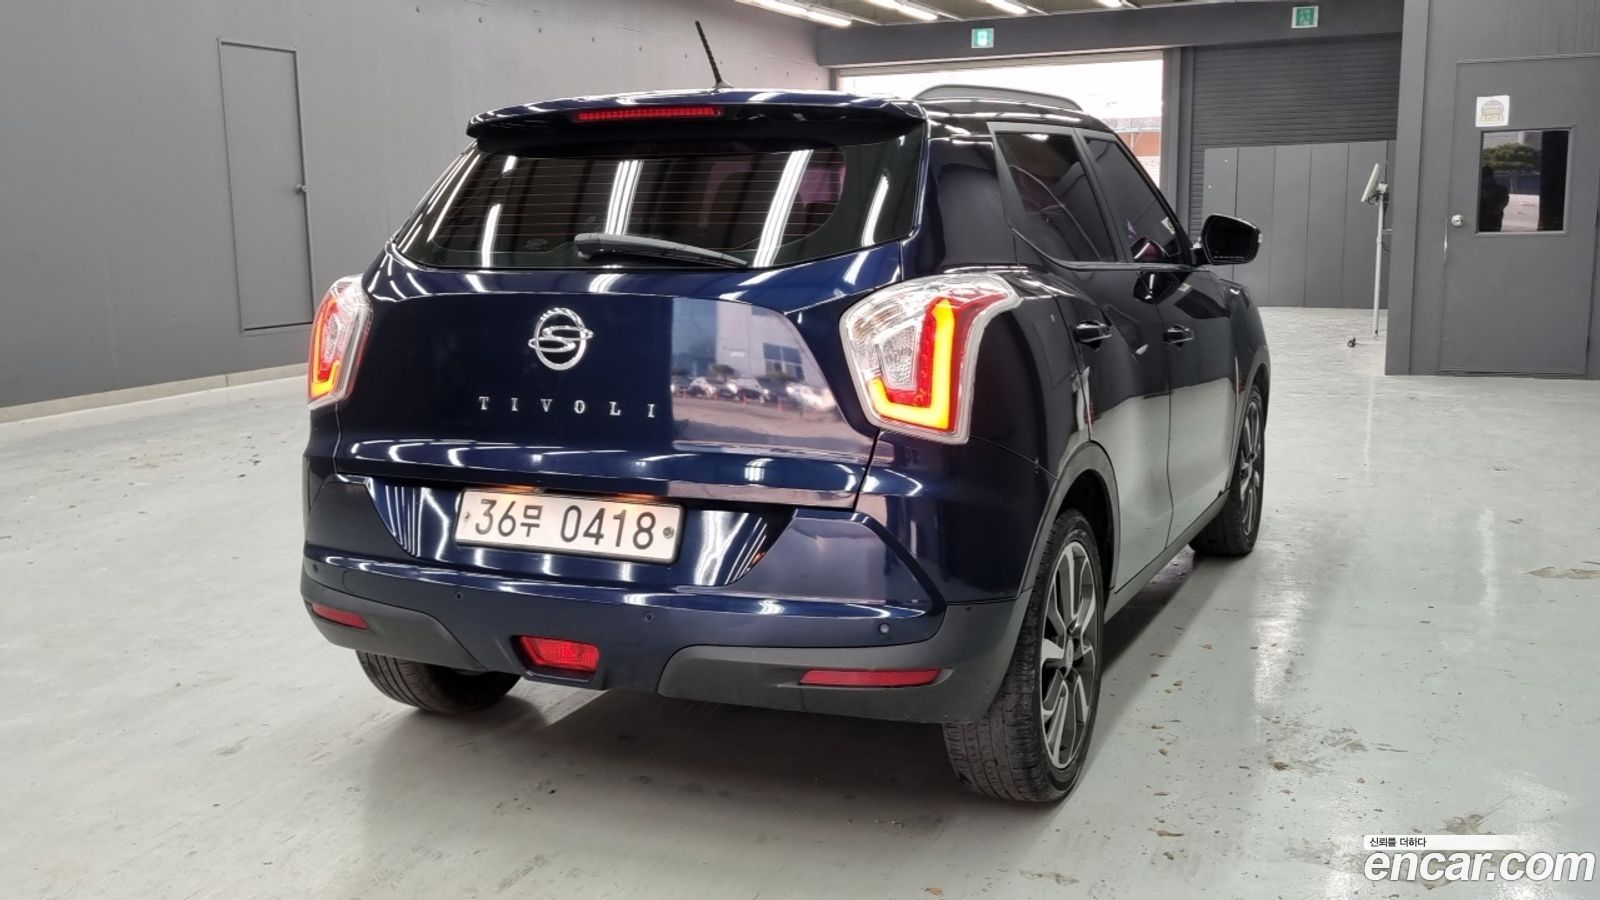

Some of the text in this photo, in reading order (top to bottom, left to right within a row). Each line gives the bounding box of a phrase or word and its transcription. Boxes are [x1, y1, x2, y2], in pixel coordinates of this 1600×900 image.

[479, 396, 655, 418] TIVOLI
[475, 498, 656, 550] 36무 0418
